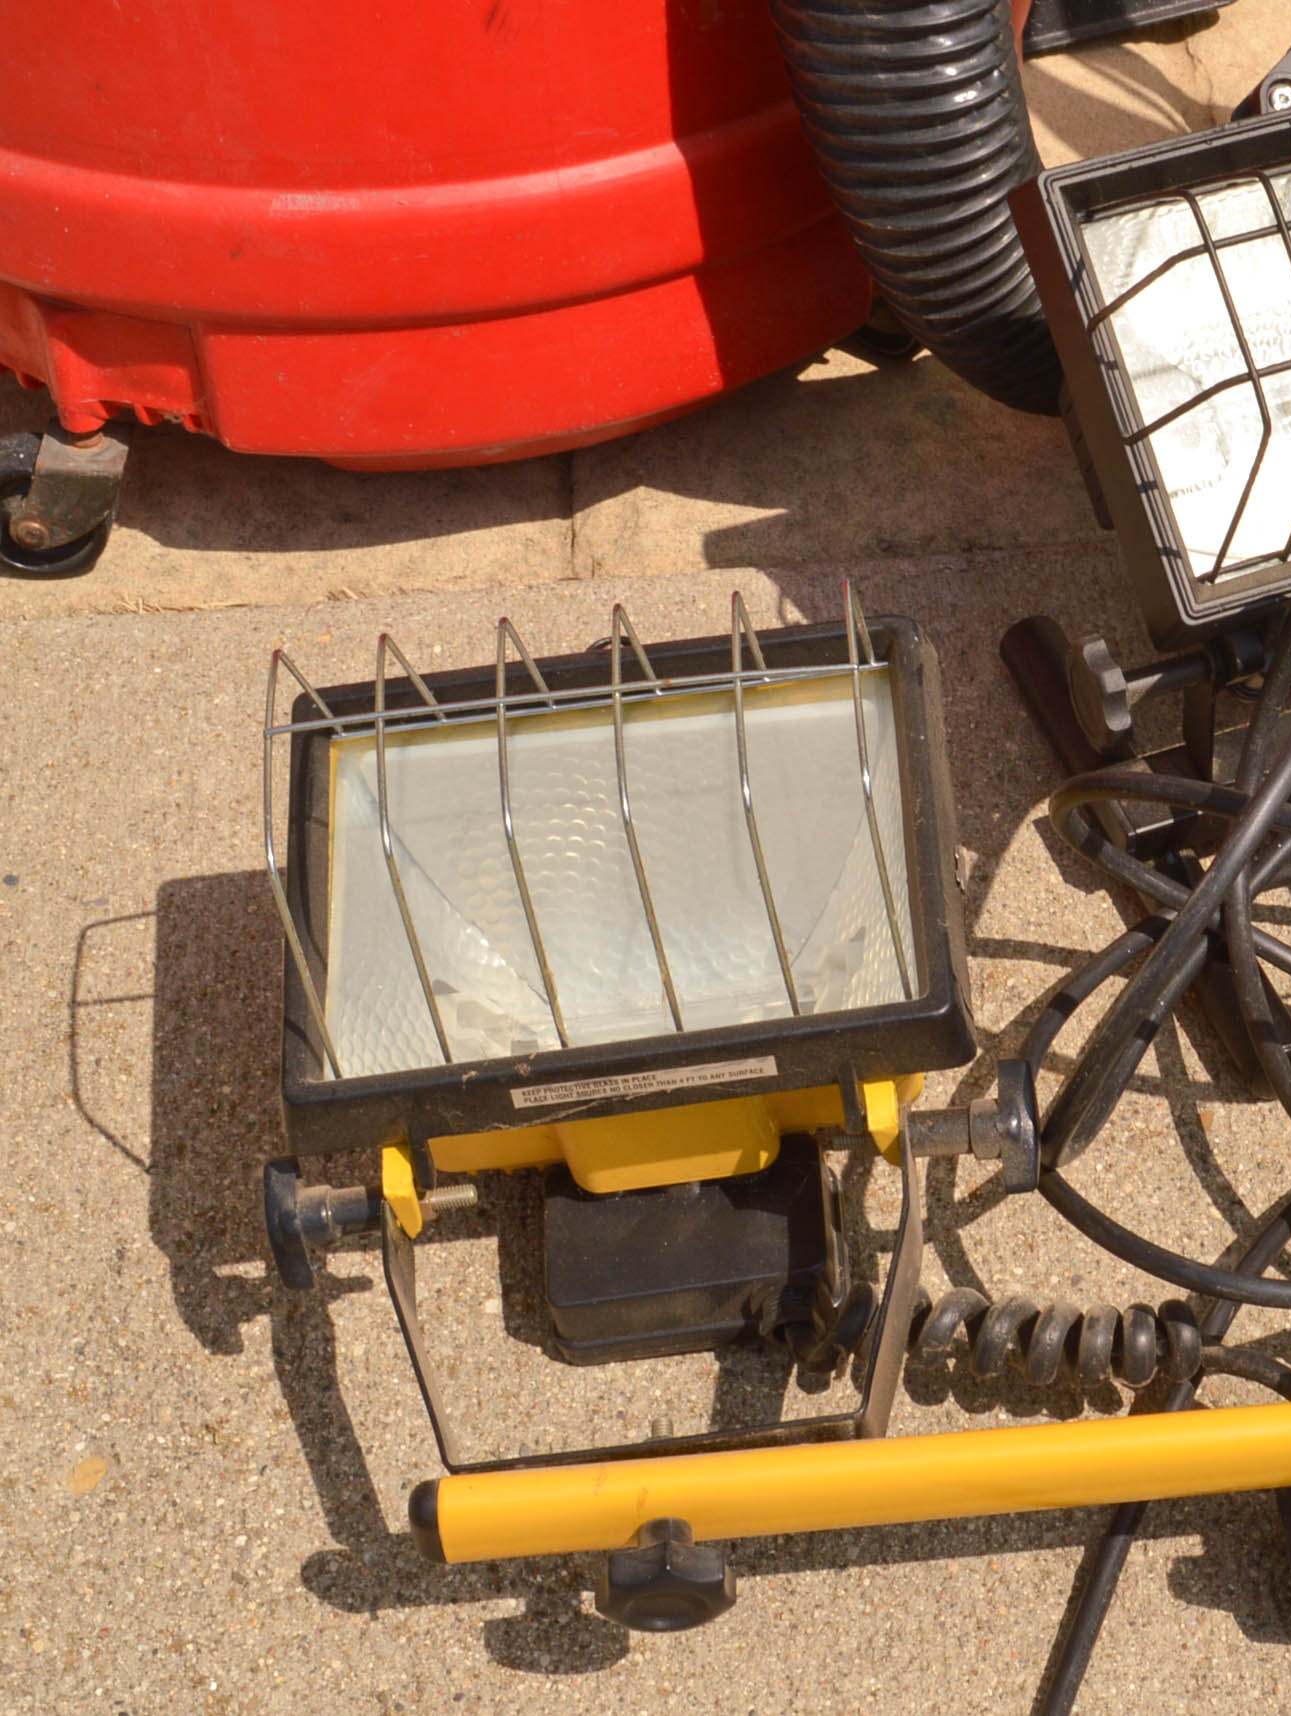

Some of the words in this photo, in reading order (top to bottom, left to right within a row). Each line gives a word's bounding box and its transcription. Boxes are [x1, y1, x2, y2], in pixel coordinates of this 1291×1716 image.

[521, 1087, 540, 1097] KEEP
[543, 1082, 590, 1094] PROTECTIVE
[620, 1076, 629, 1084] IN
[631, 1073, 656, 1083] PLACE
[523, 1095, 544, 1104] PLACE
[550, 1091, 574, 1101] LIGHT
[575, 1087, 607, 1098] SOURCE
[609, 1085, 621, 1093] NO
[622, 1081, 655, 1092] CLOSER
[655, 1078, 676, 1087] THAN
[709, 1071, 725, 1080] ANY
[727, 1067, 764, 1077] SURFACE
